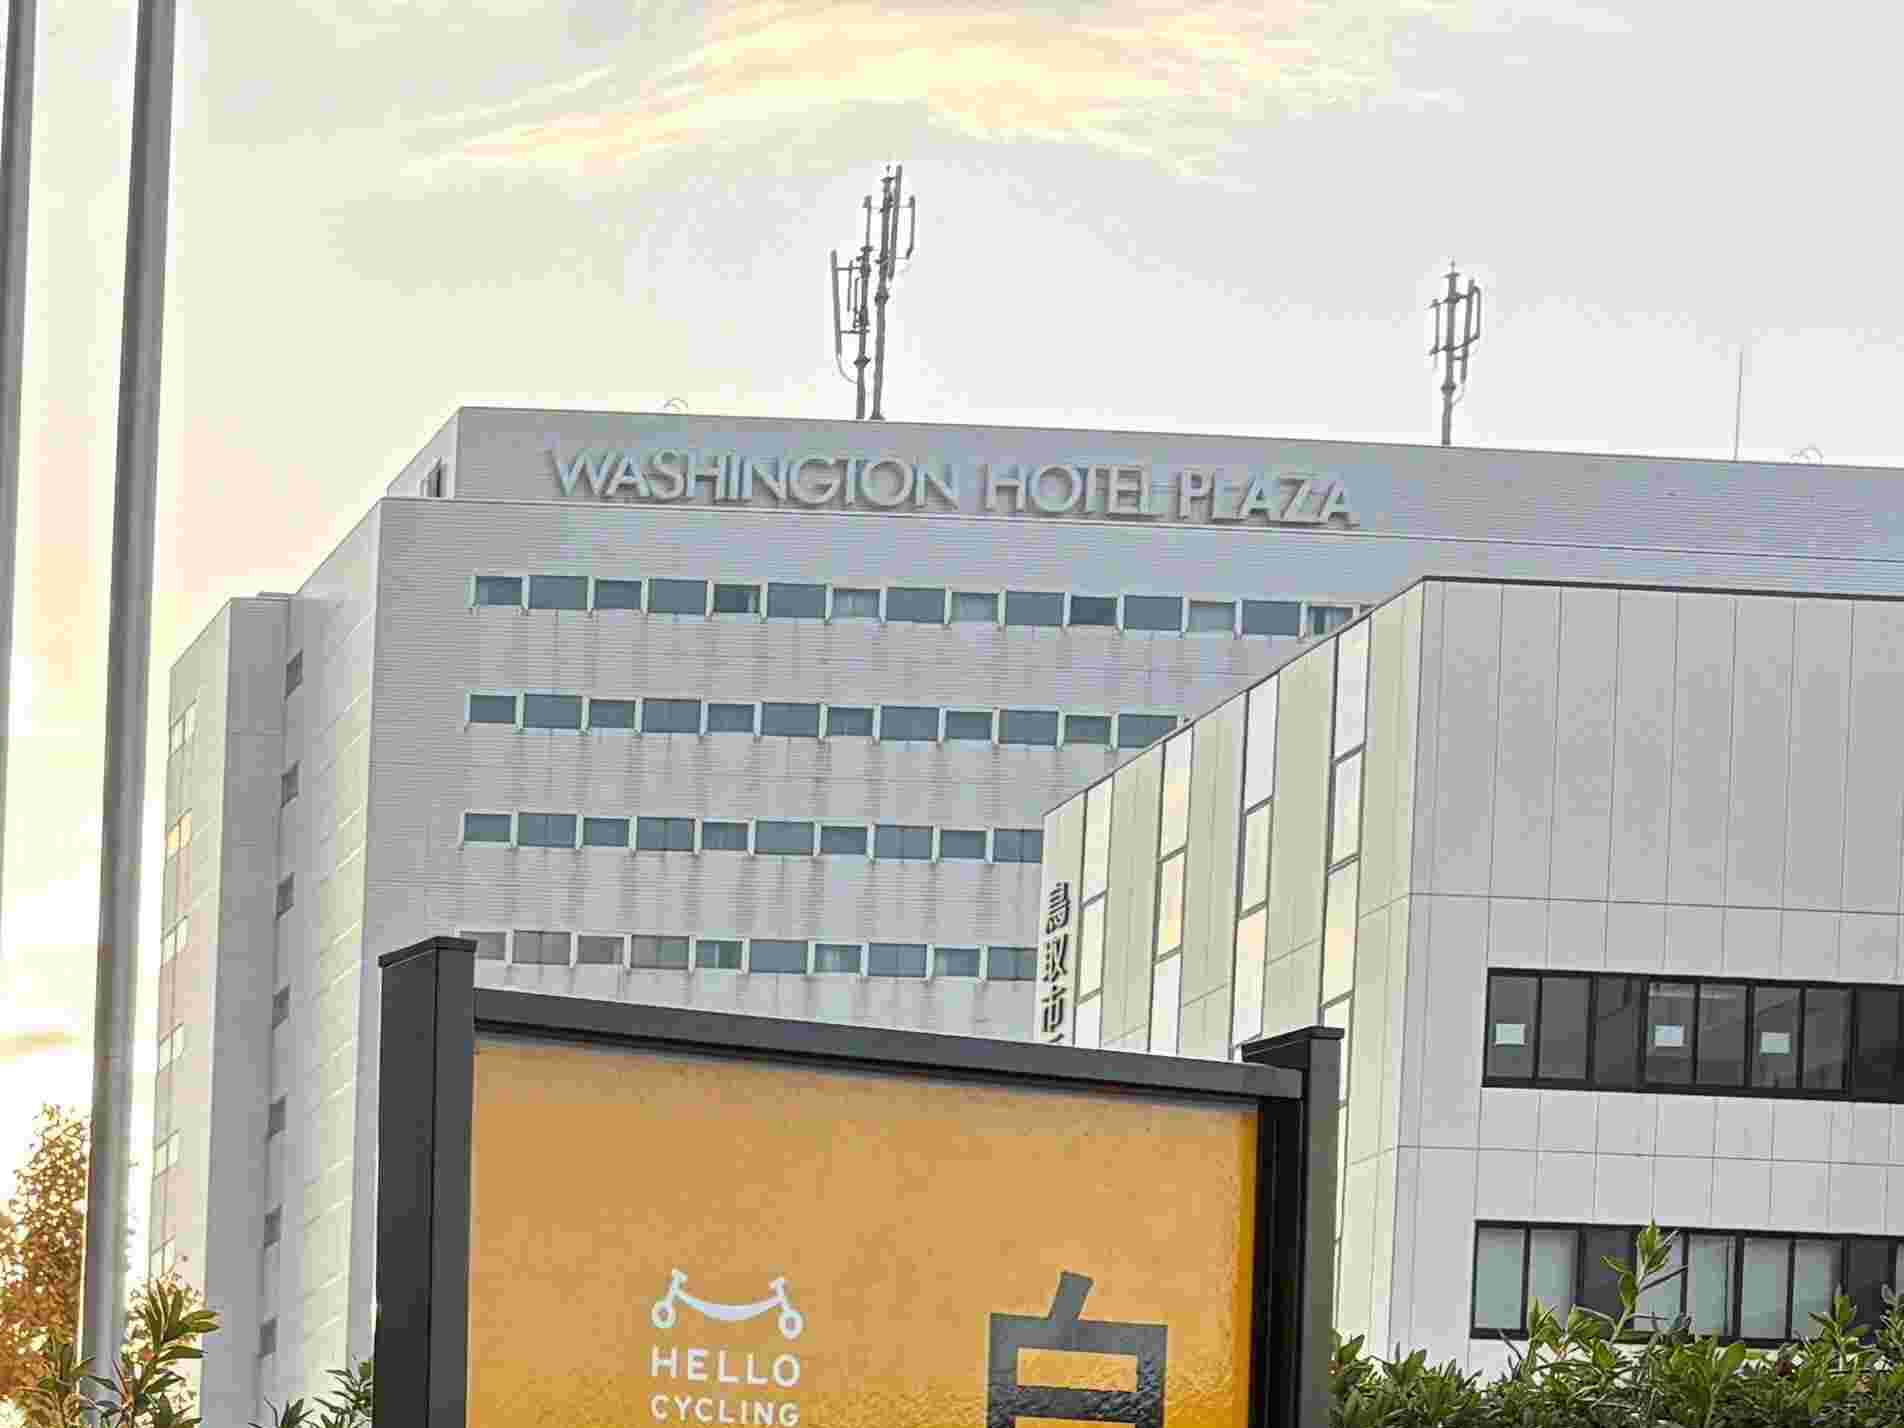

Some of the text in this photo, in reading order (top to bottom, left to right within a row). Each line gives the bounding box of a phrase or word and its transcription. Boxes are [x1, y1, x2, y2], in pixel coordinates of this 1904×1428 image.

[552, 446, 1356, 526] WASHINGTON HOTEL PLAZA
[1041, 881, 1072, 1042] 鳥取市
[650, 1345, 801, 1387] HELLO
[650, 1394, 800, 1428] CYCLING
